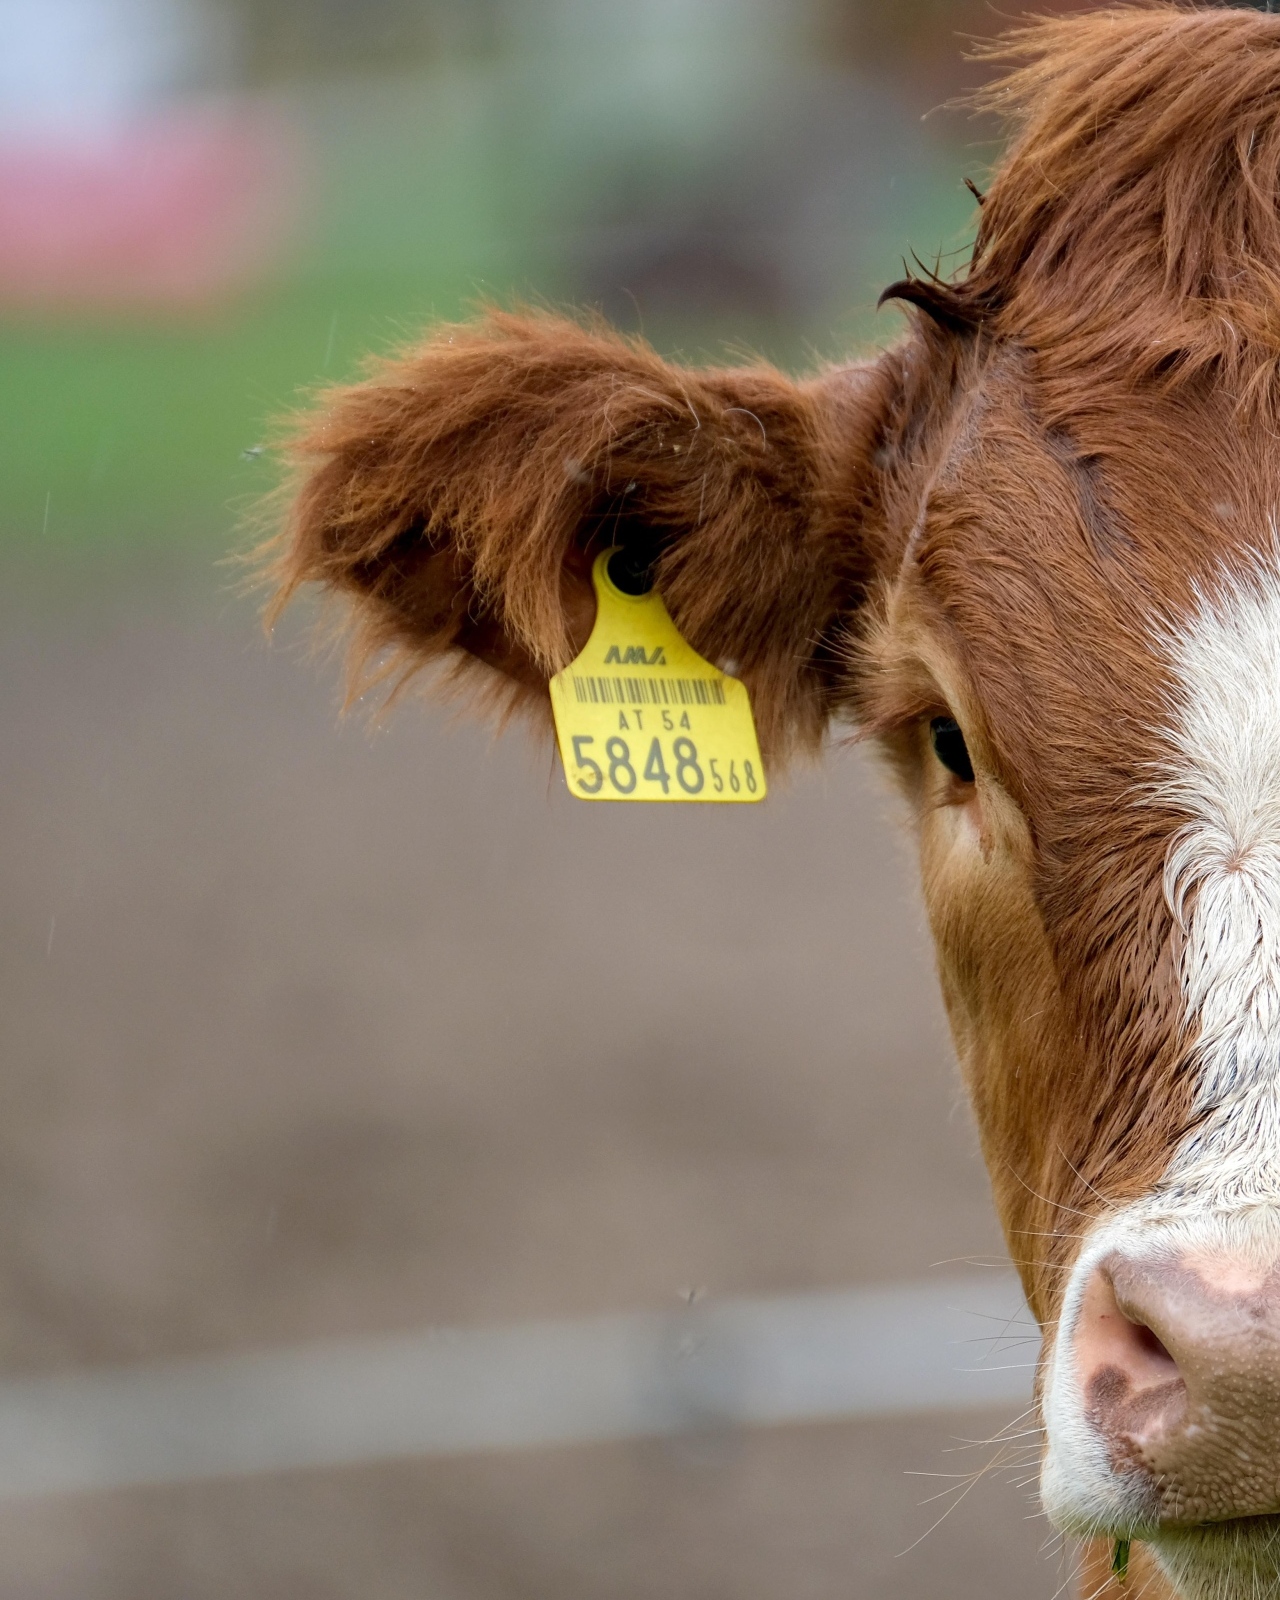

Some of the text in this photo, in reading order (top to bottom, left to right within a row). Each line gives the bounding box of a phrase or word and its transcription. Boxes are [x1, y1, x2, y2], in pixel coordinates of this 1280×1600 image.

[604, 645, 666, 665] AMA
[618, 709, 691, 731] AT 54
[571, 735, 757, 794] 5848 568
